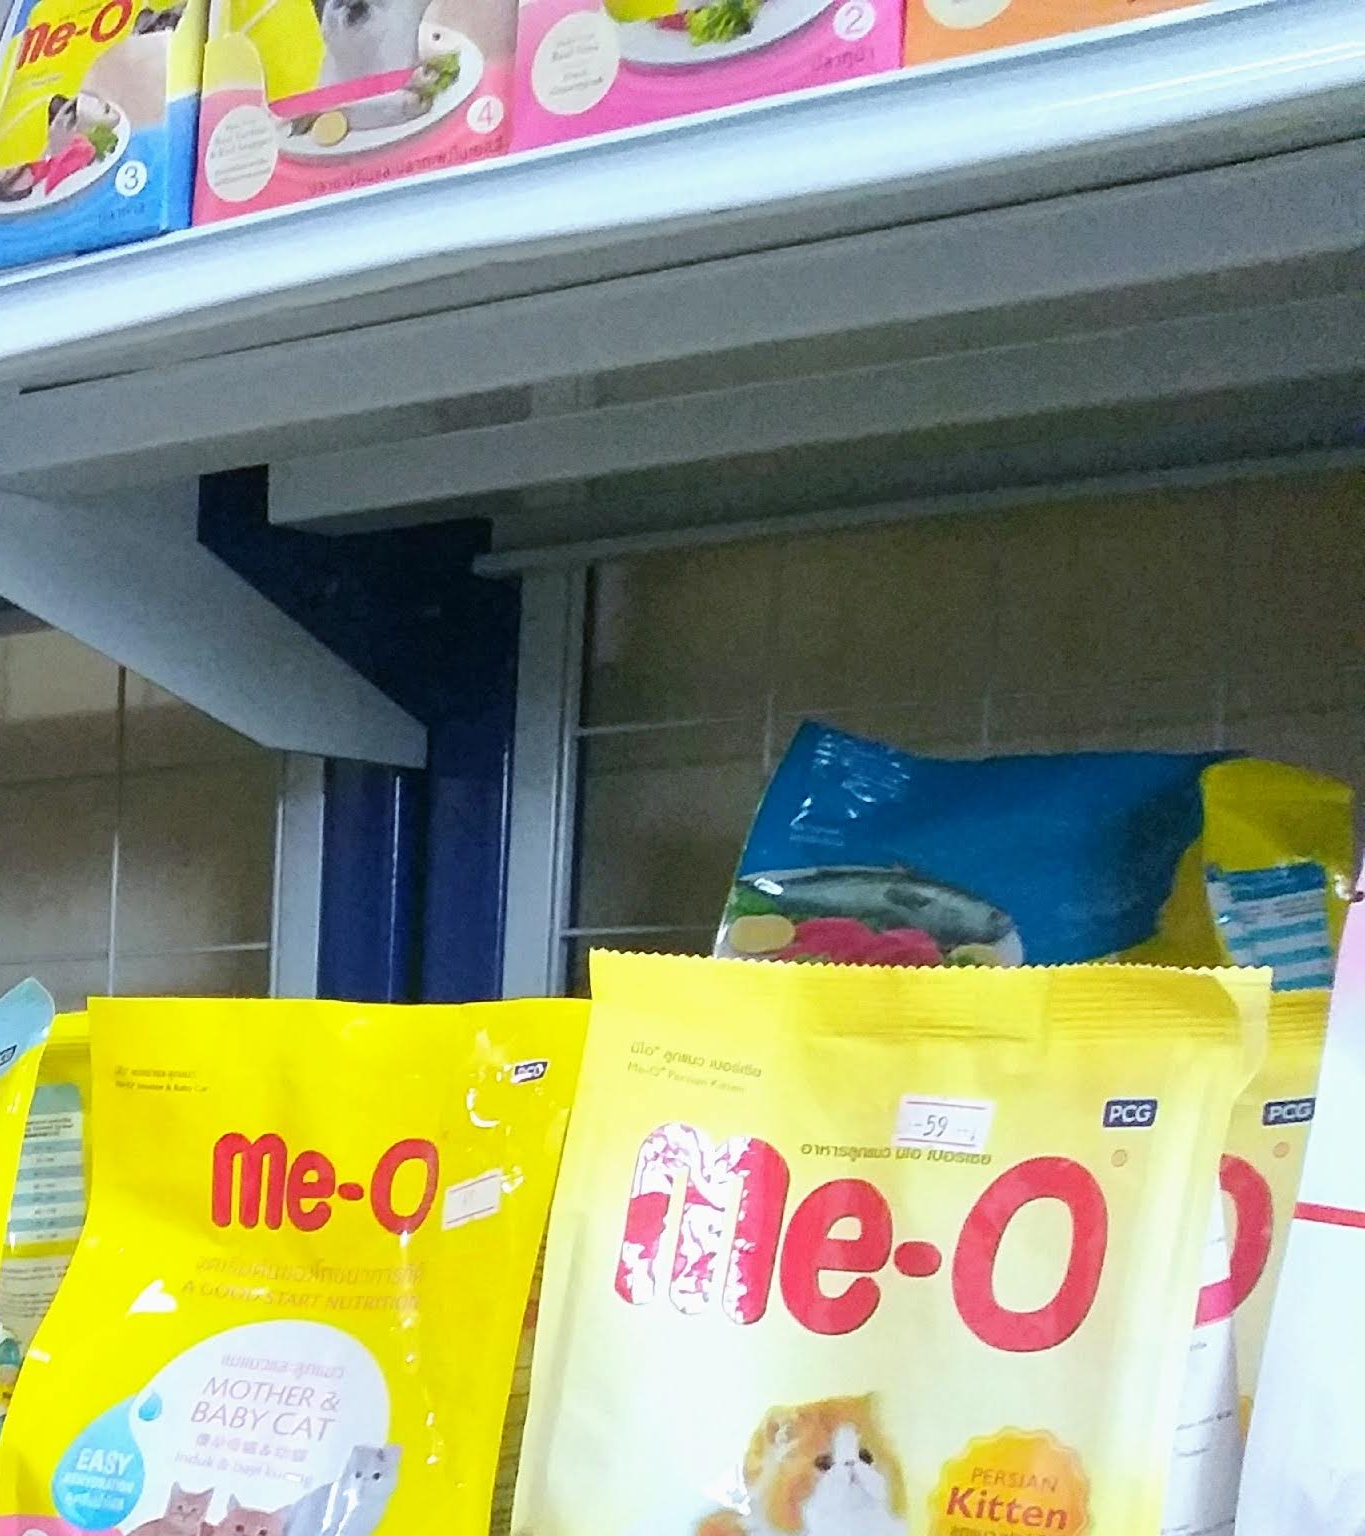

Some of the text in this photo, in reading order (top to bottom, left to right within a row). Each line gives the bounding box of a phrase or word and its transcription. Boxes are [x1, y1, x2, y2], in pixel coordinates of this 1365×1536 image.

[845, 8, 865, 32] 2
[476, 101, 492, 126] 4
[124, 166, 138, 190] 3
[1107, 1104, 1153, 1124] PCG
[1268, 1101, 1313, 1122] PCG
[211, 1131, 439, 1235] Me-O
[615, 1121, 1109, 1353] Me-O
[202, 1376, 342, 1412] MOTHER &
[190, 1401, 336, 1442] BABY CAT
[75, 1447, 135, 1477] EASY
[971, 1466, 1060, 1493] PERSIAN
[946, 1486, 1069, 1531] Kitten
